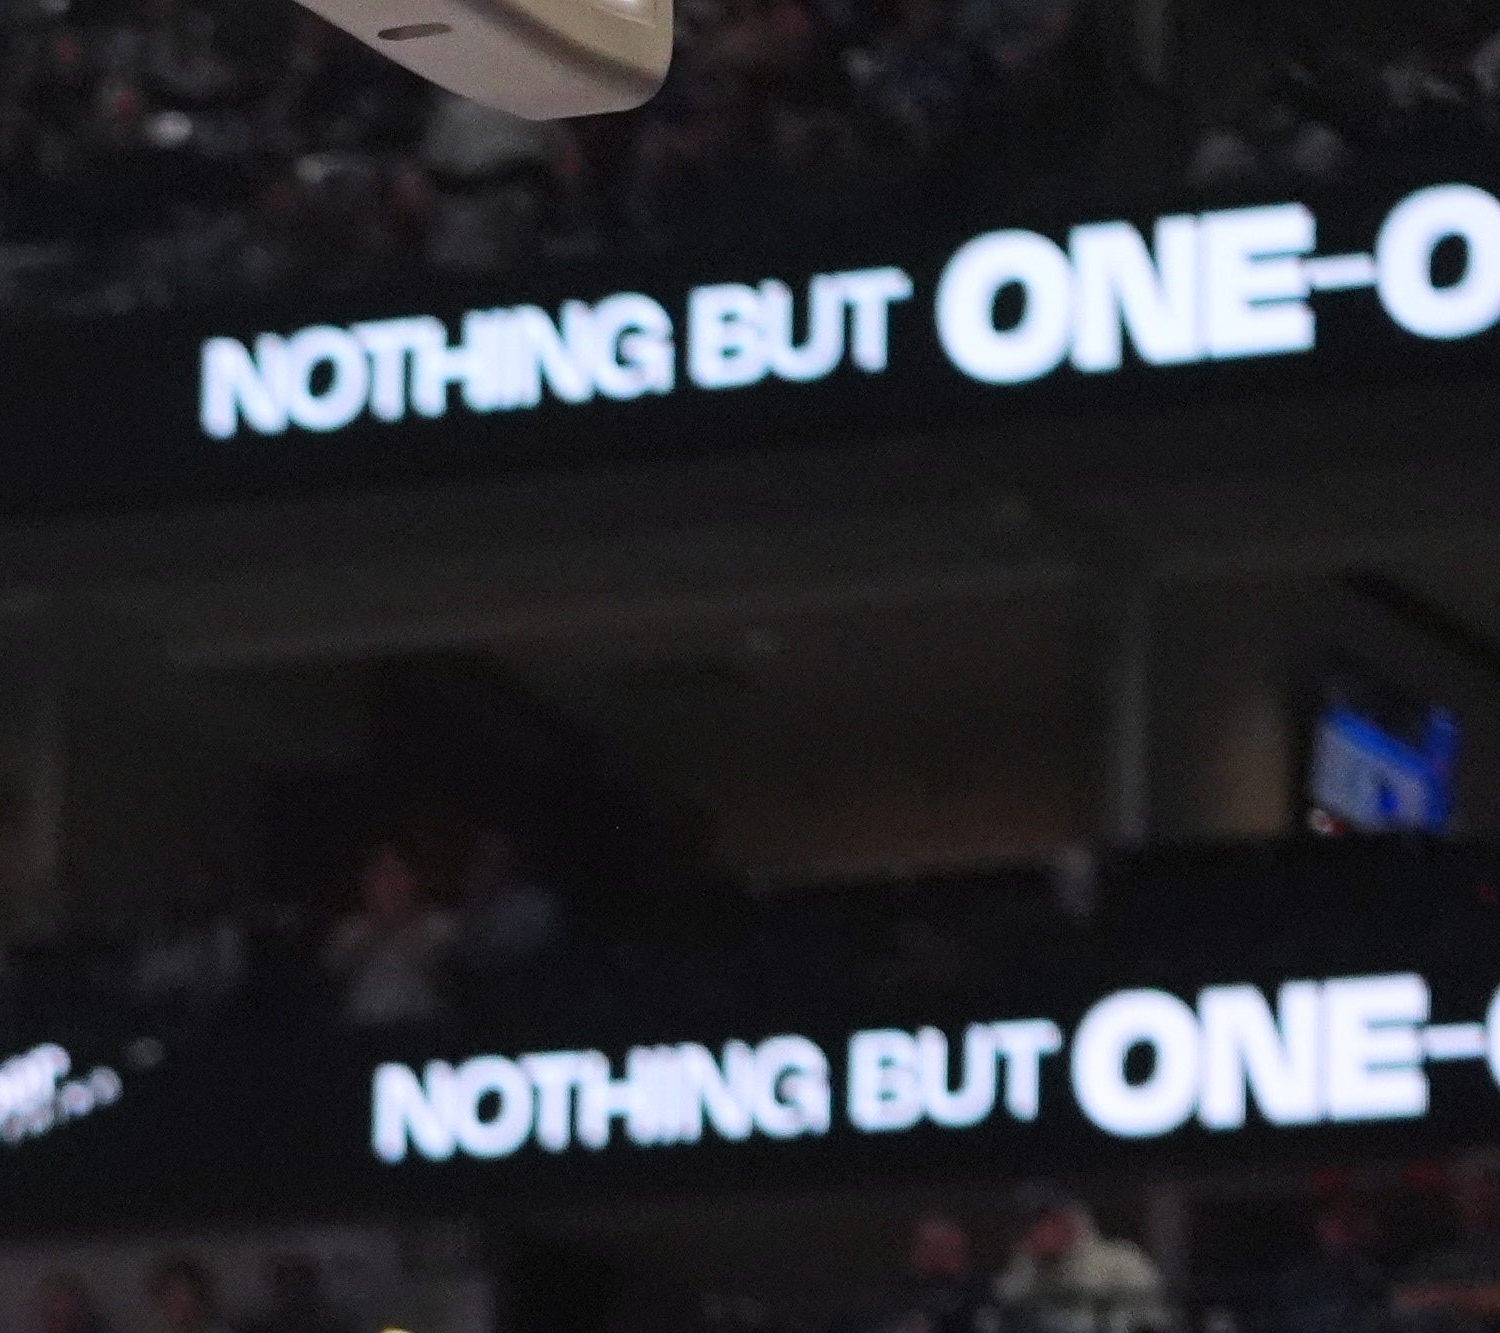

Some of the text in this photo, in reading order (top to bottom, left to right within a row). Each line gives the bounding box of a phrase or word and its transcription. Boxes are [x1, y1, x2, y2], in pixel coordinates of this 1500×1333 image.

[201, 293, 674, 438] NOTHING
[688, 266, 913, 389] BUT
[371, 971, 1500, 1163] NOTHING BUT ONE-
